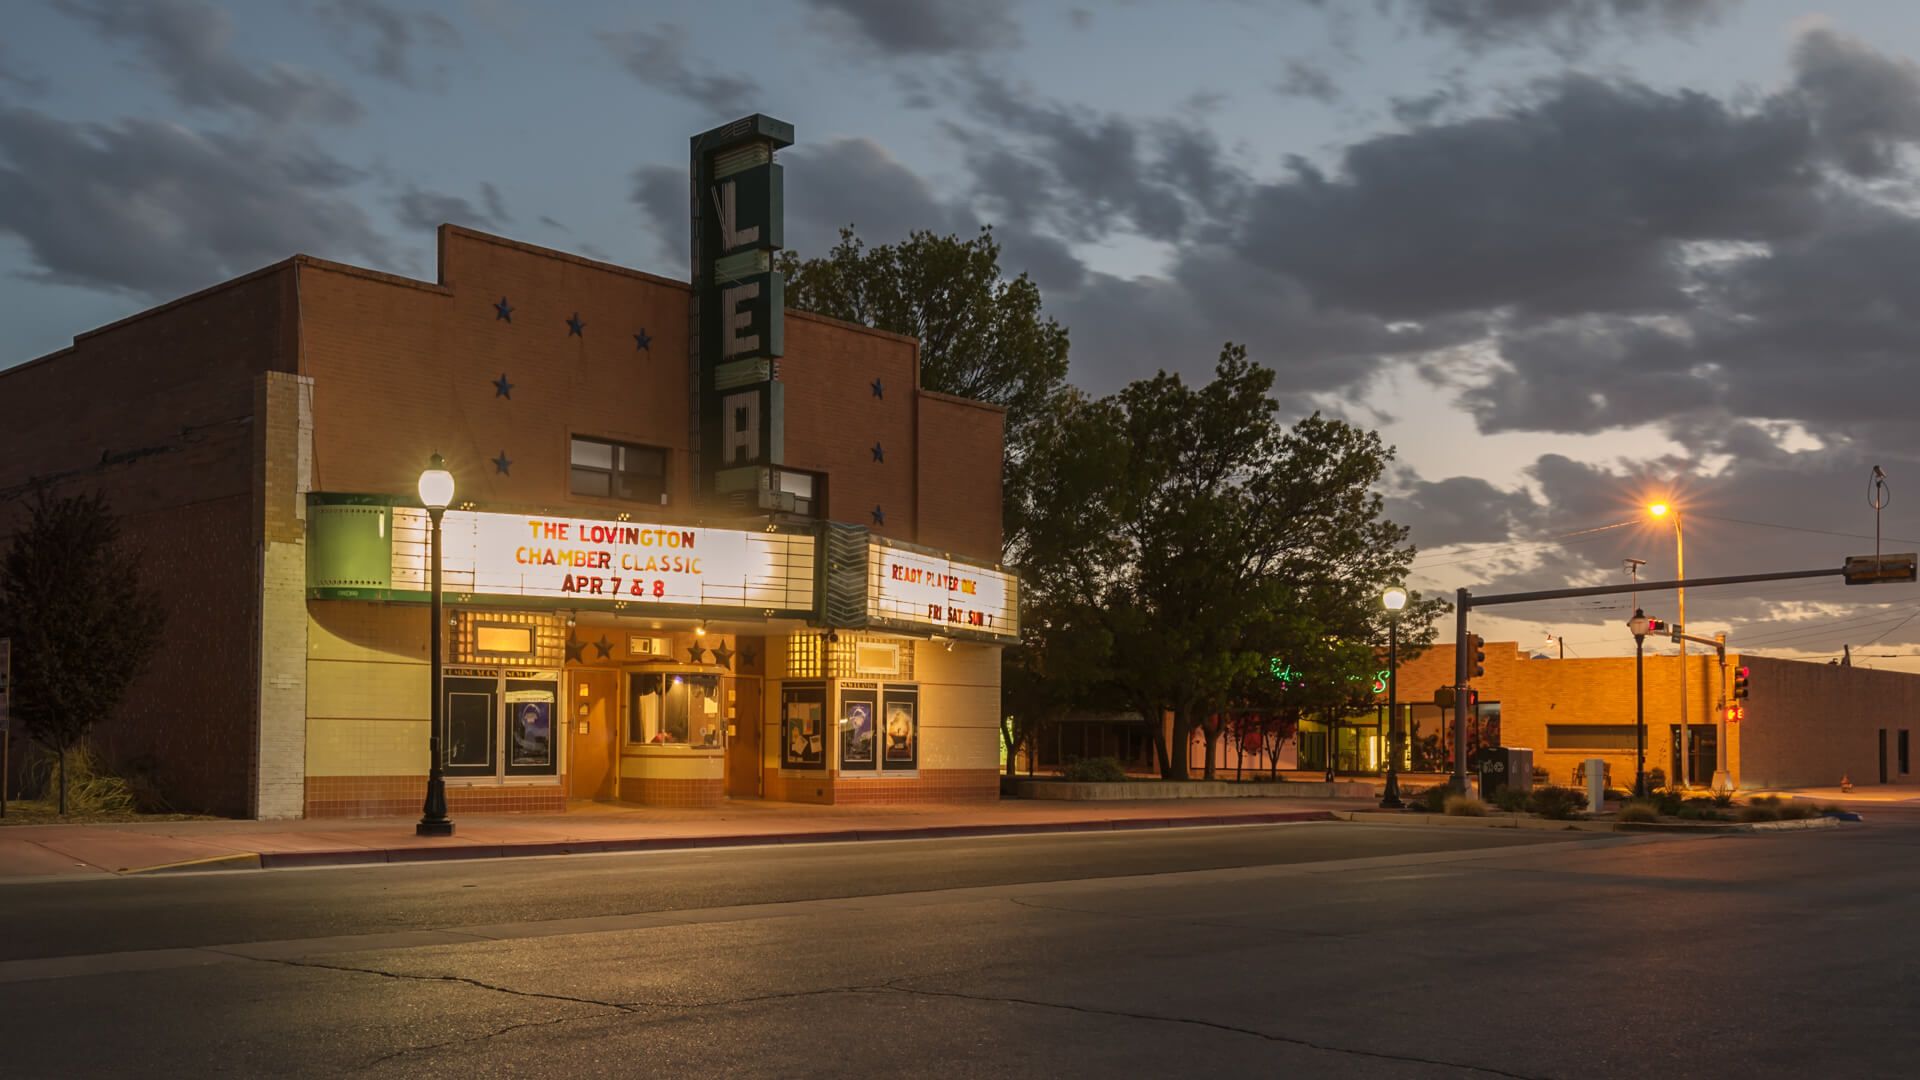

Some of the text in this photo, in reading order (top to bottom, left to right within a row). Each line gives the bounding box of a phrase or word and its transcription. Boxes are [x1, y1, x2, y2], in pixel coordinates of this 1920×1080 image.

[721, 178, 760, 467] LEA
[528, 520, 695, 549] THE LOVINGTON
[515, 546, 703, 574] CHAMBER CLASSIC
[561, 573, 665, 597] APR 7 & 8
[892, 564, 977, 595] READY PLAYER ONE
[928, 604, 993, 628] FRI SAT SUN 7
